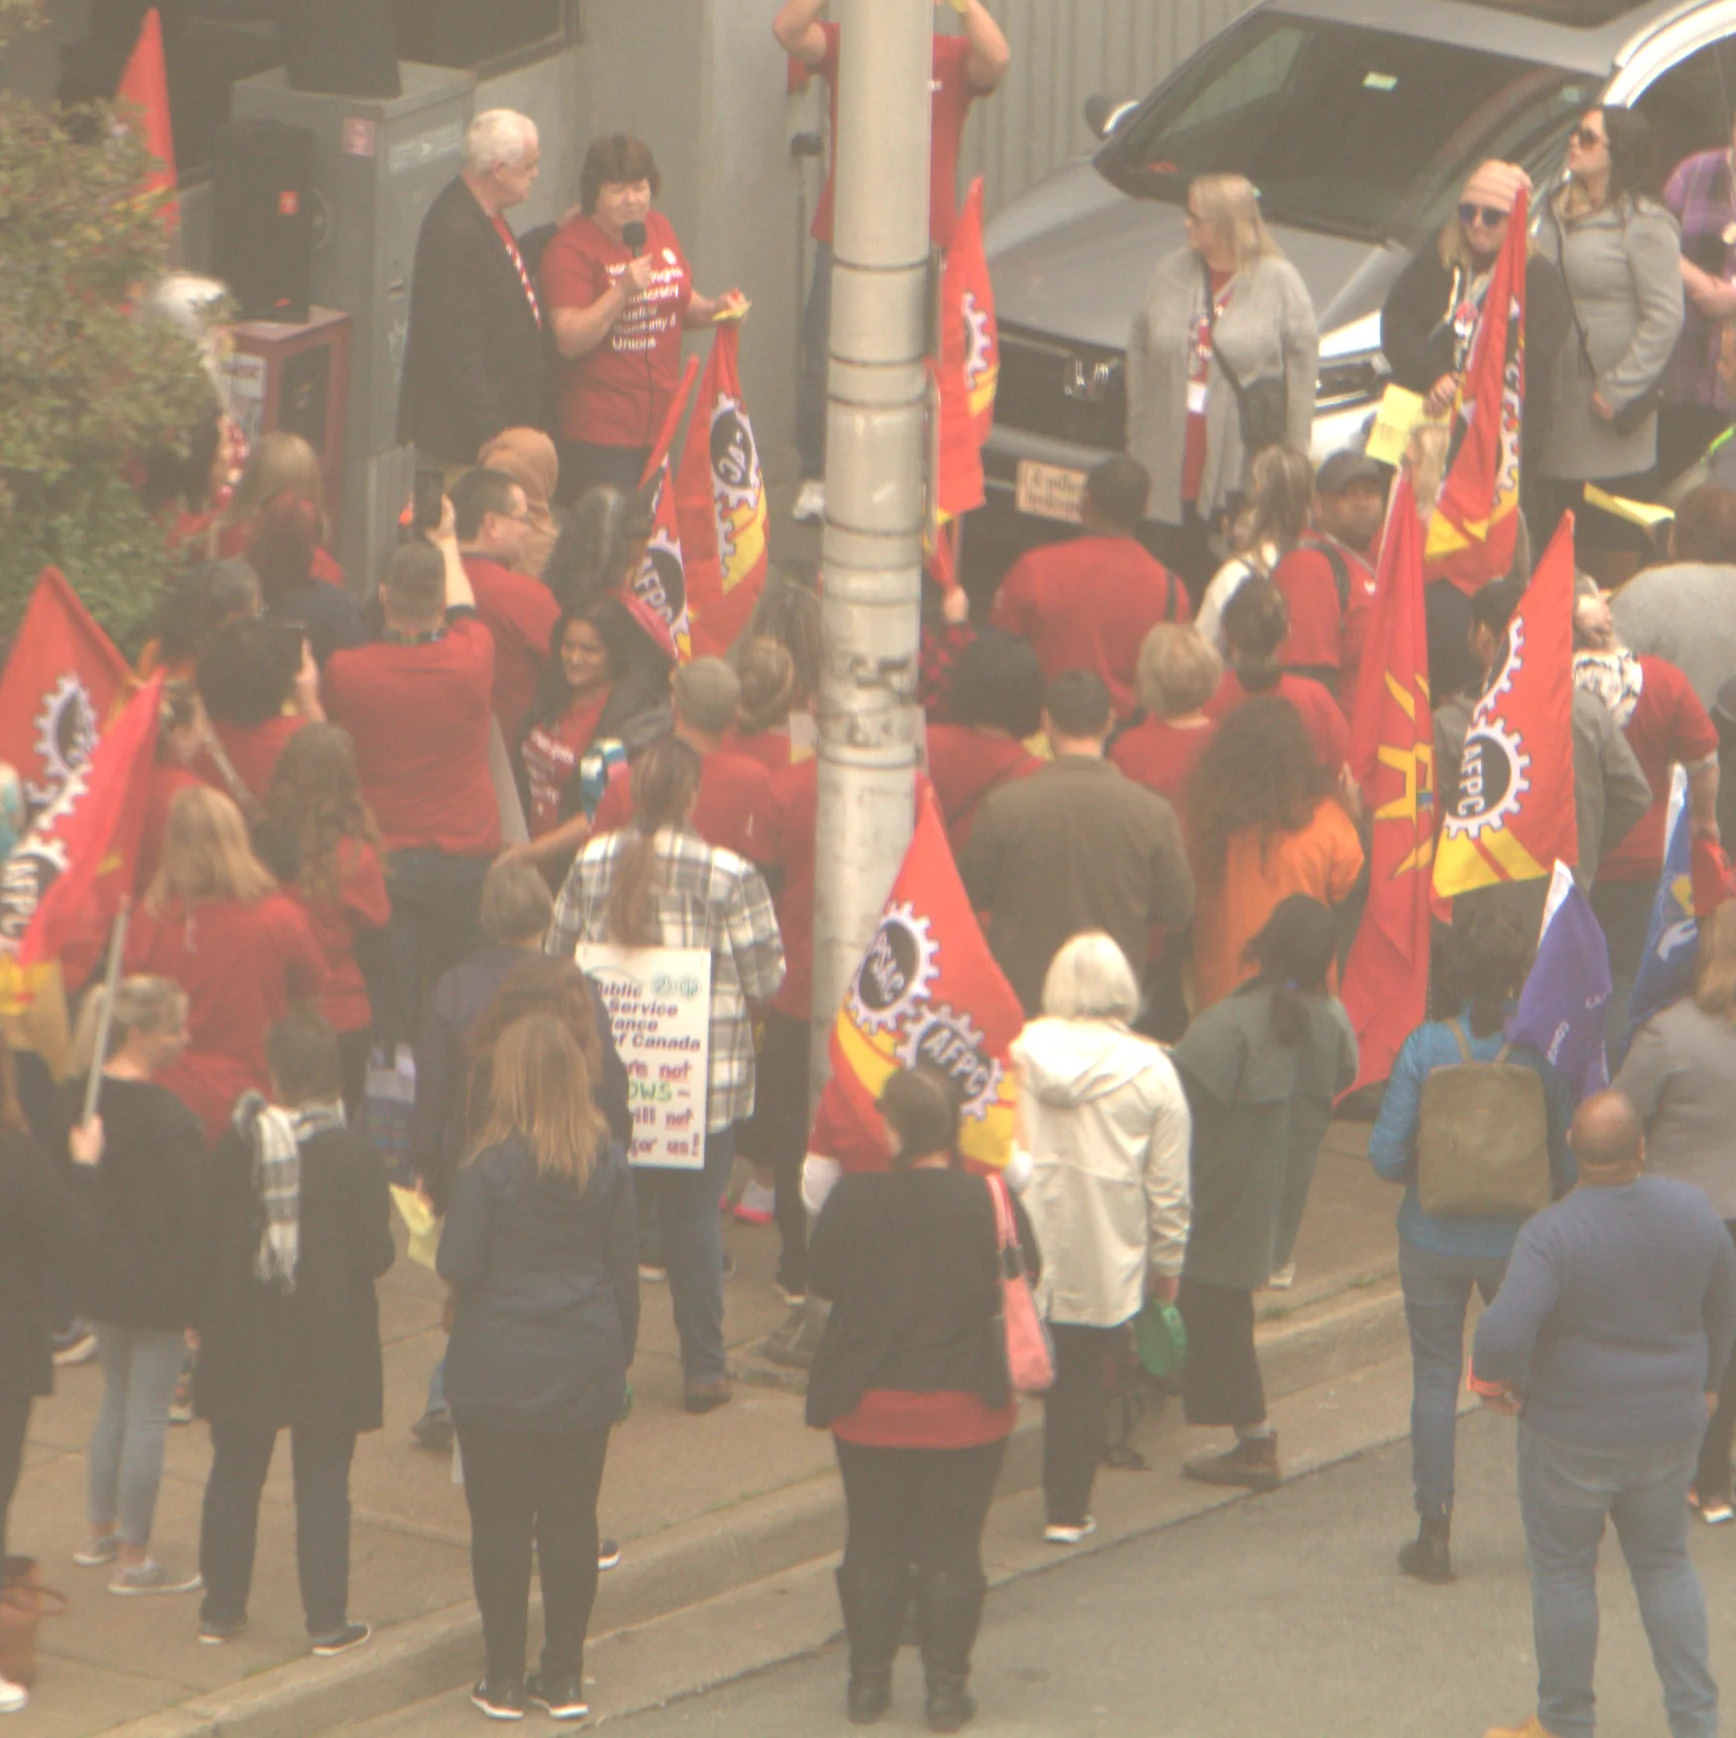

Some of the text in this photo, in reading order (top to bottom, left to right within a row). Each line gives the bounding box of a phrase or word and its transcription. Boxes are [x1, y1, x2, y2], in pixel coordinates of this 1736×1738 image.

[1457, 743, 1486, 818] AFPC
[871, 929, 905, 1003] PSAC
[631, 1032, 702, 1053] Canada
[923, 1026, 989, 1096] AFPC
